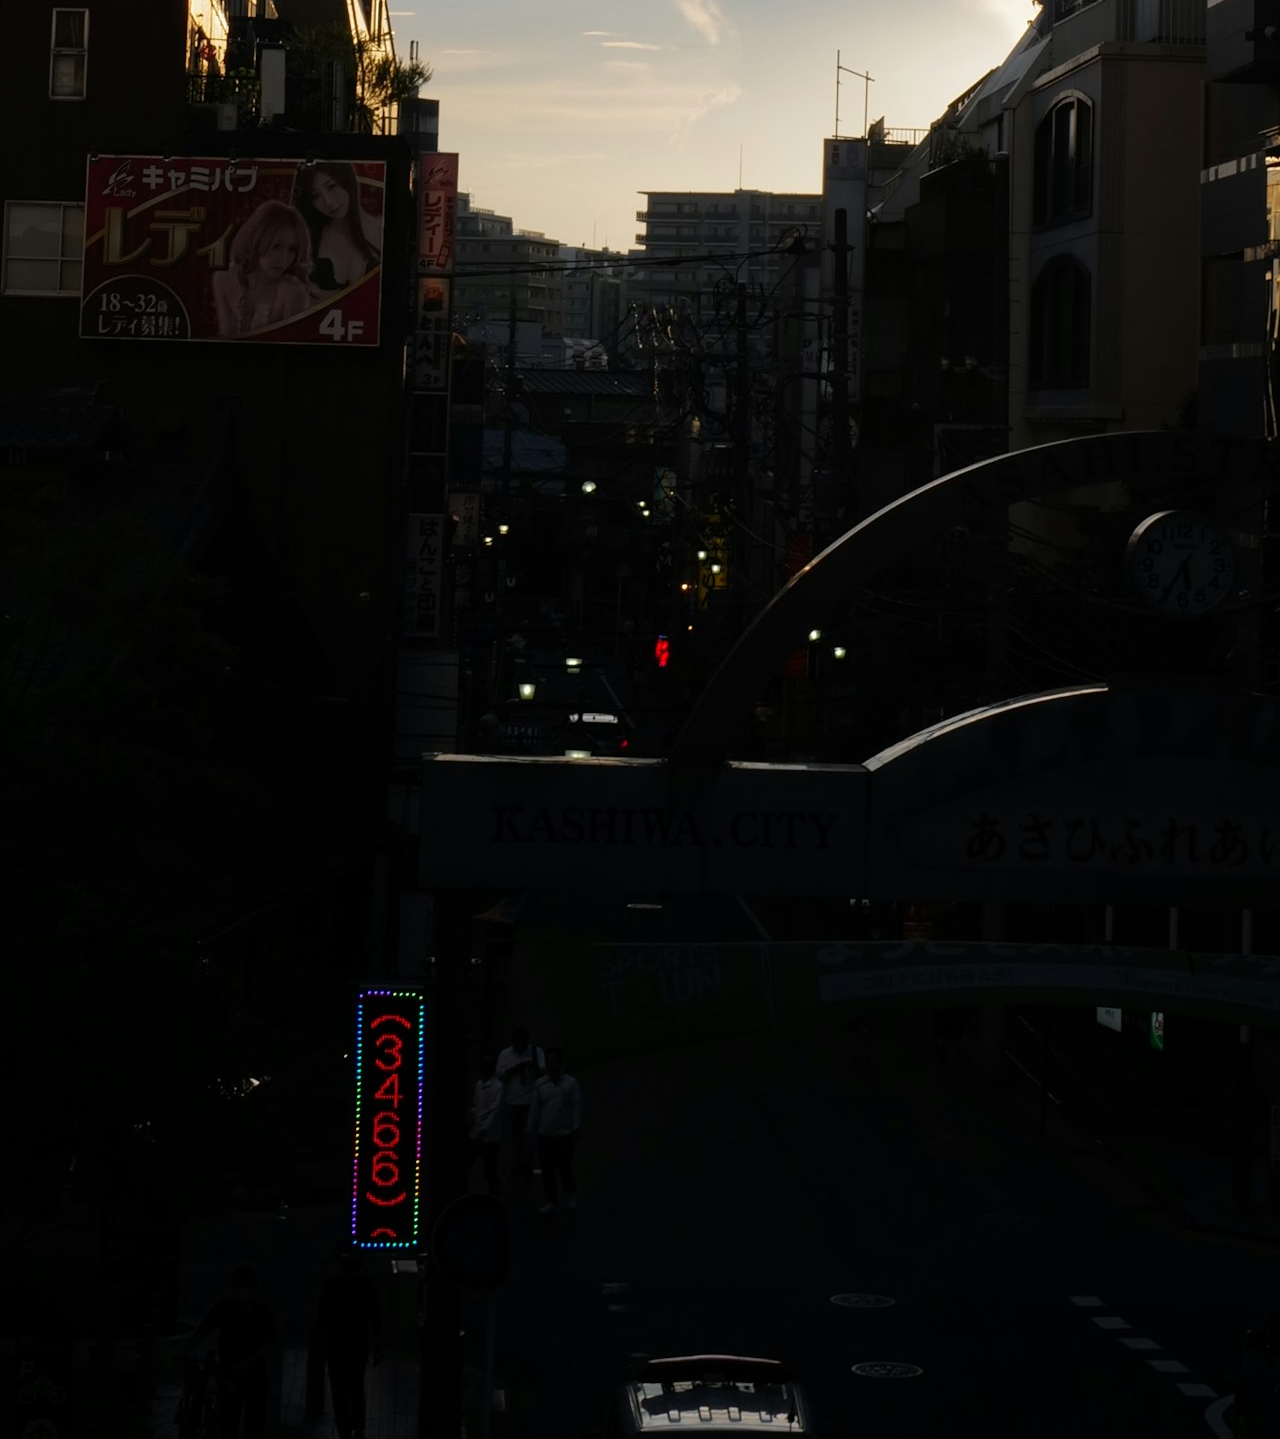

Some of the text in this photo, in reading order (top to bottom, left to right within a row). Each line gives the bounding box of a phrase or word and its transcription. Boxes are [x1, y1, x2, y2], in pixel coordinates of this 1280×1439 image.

[141, 164, 258, 193] キャミパブ
[102, 205, 236, 270] レディ
[318, 308, 365, 342] 4F
